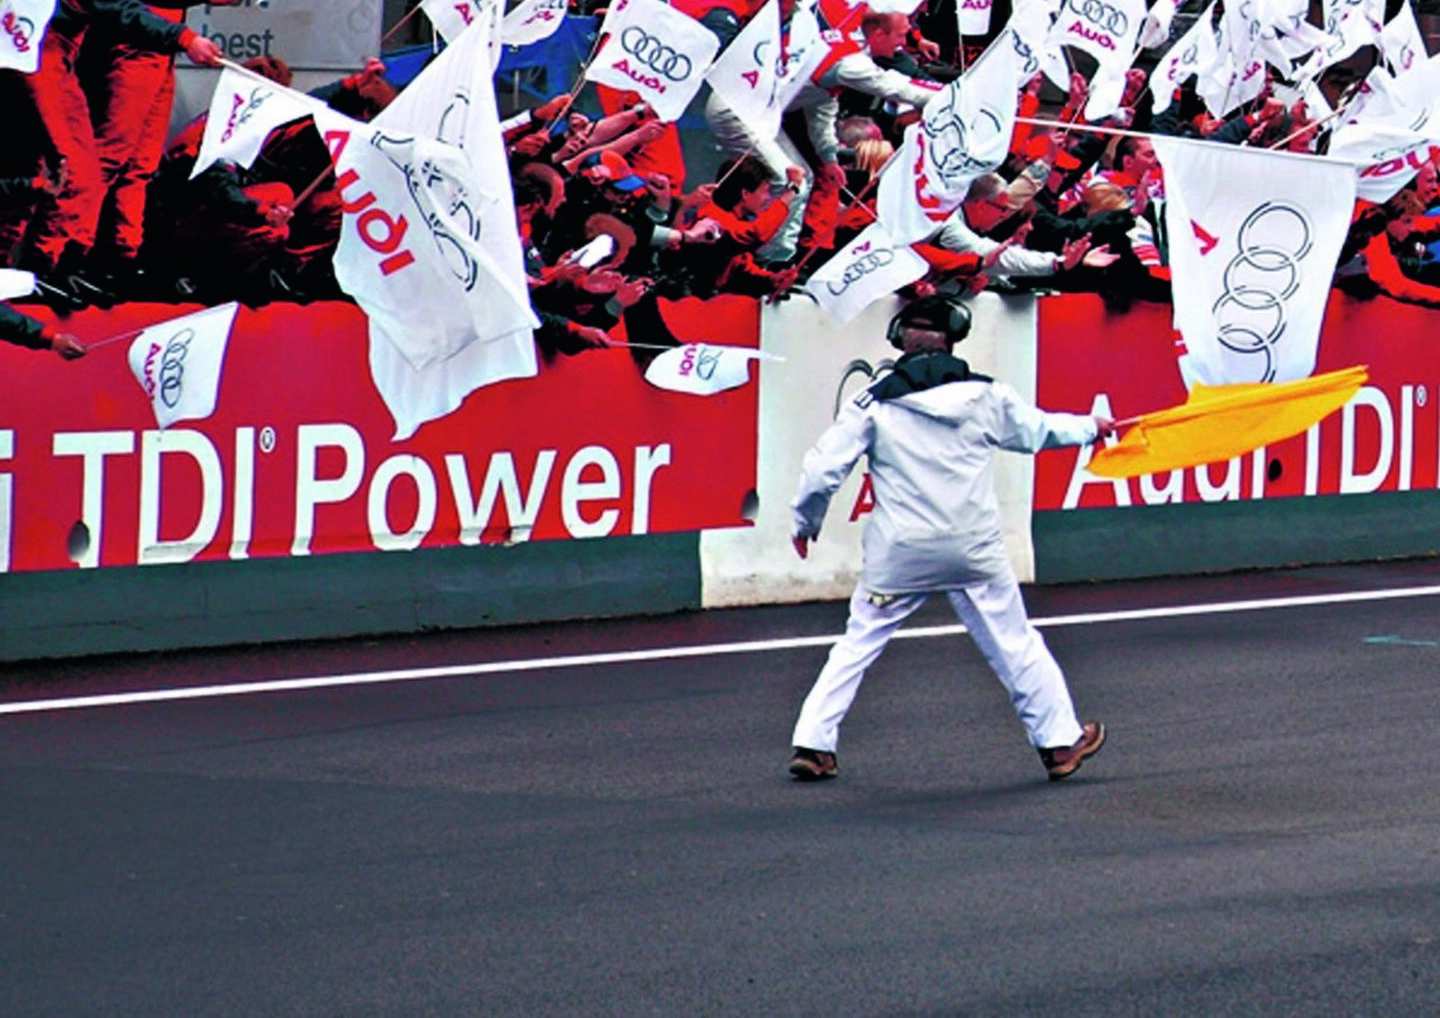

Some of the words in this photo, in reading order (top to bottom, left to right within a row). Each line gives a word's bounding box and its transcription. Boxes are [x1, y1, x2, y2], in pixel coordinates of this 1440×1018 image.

[611, 59, 667, 94] Audi
[678, 343, 697, 377] udi
[290, 422, 671, 557] Power
